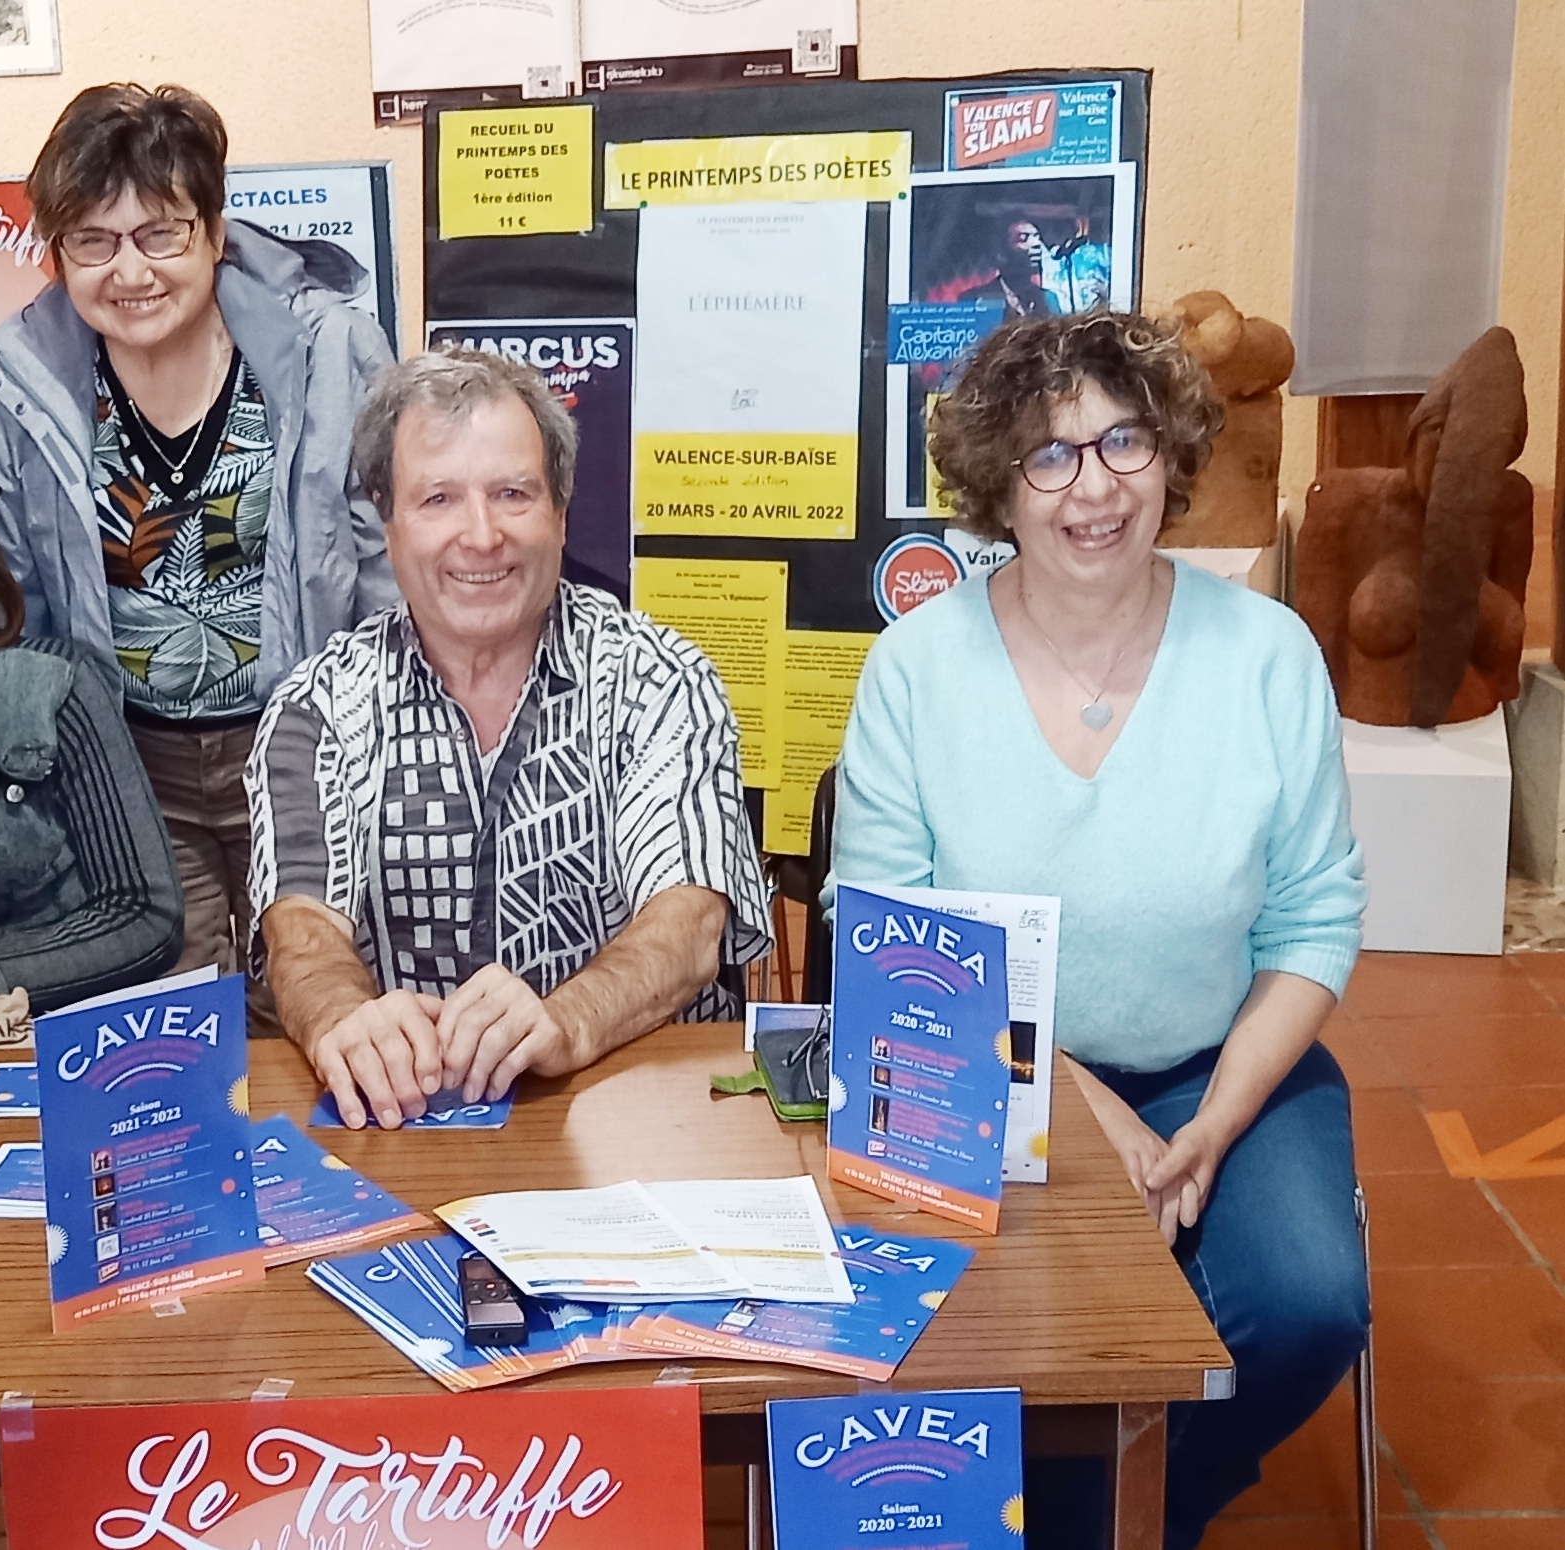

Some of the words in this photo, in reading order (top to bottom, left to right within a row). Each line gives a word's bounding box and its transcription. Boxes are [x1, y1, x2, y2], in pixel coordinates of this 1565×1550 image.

[1062, 90, 1108, 103] Valence
[963, 100, 1033, 124] VALENCE
[470, 124, 530, 137] RECUEIL
[534, 123, 554, 135] DU
[964, 121, 987, 134] TON
[456, 145, 536, 159] PRINTEMPS
[541, 144, 568, 156] DES
[621, 172, 642, 190] LE
[648, 165, 762, 190] PRINTEMPS
[769, 163, 807, 182] DES
[814, 156, 892, 181] POÈTES
[226, 188, 328, 208] CTACLES
[506, 191, 553, 204] édition
[308, 221, 354, 237] 2022
[498, 216, 513, 228] 11
[688, 291, 808, 313] L'ÉPHÉMÈRE
[899, 325, 978, 351] Capitaine
[653, 447, 837, 466] VALENCE-SUR-BAÏSE
[646, 503, 664, 517] 20
[668, 503, 715, 518] MARS
[729, 504, 747, 518] 20
[752, 504, 802, 519] AVRIL
[807, 506, 844, 520] 2022
[892, 571, 949, 610] Slam
[851, 912, 986, 987] CAVEA
[890, 1011, 918, 1030] 2020
[925, 1021, 952, 1039] 2021
[57, 1006, 221, 1082] CAVEA
[129, 1100, 162, 1116] Saison
[109, 1116, 140, 1137] 2021
[150, 1106, 182, 1126] 2022
[838, 1233, 937, 1273] VEA
[795, 1406, 990, 1469] CAVEA
[93, 1429, 239, 1550] Le
[245, 1427, 622, 1550] Tartuffe
[881, 1503, 920, 1516] Saison
[858, 1517, 896, 1533] 2020
[907, 1514, 943, 1529] 2021
